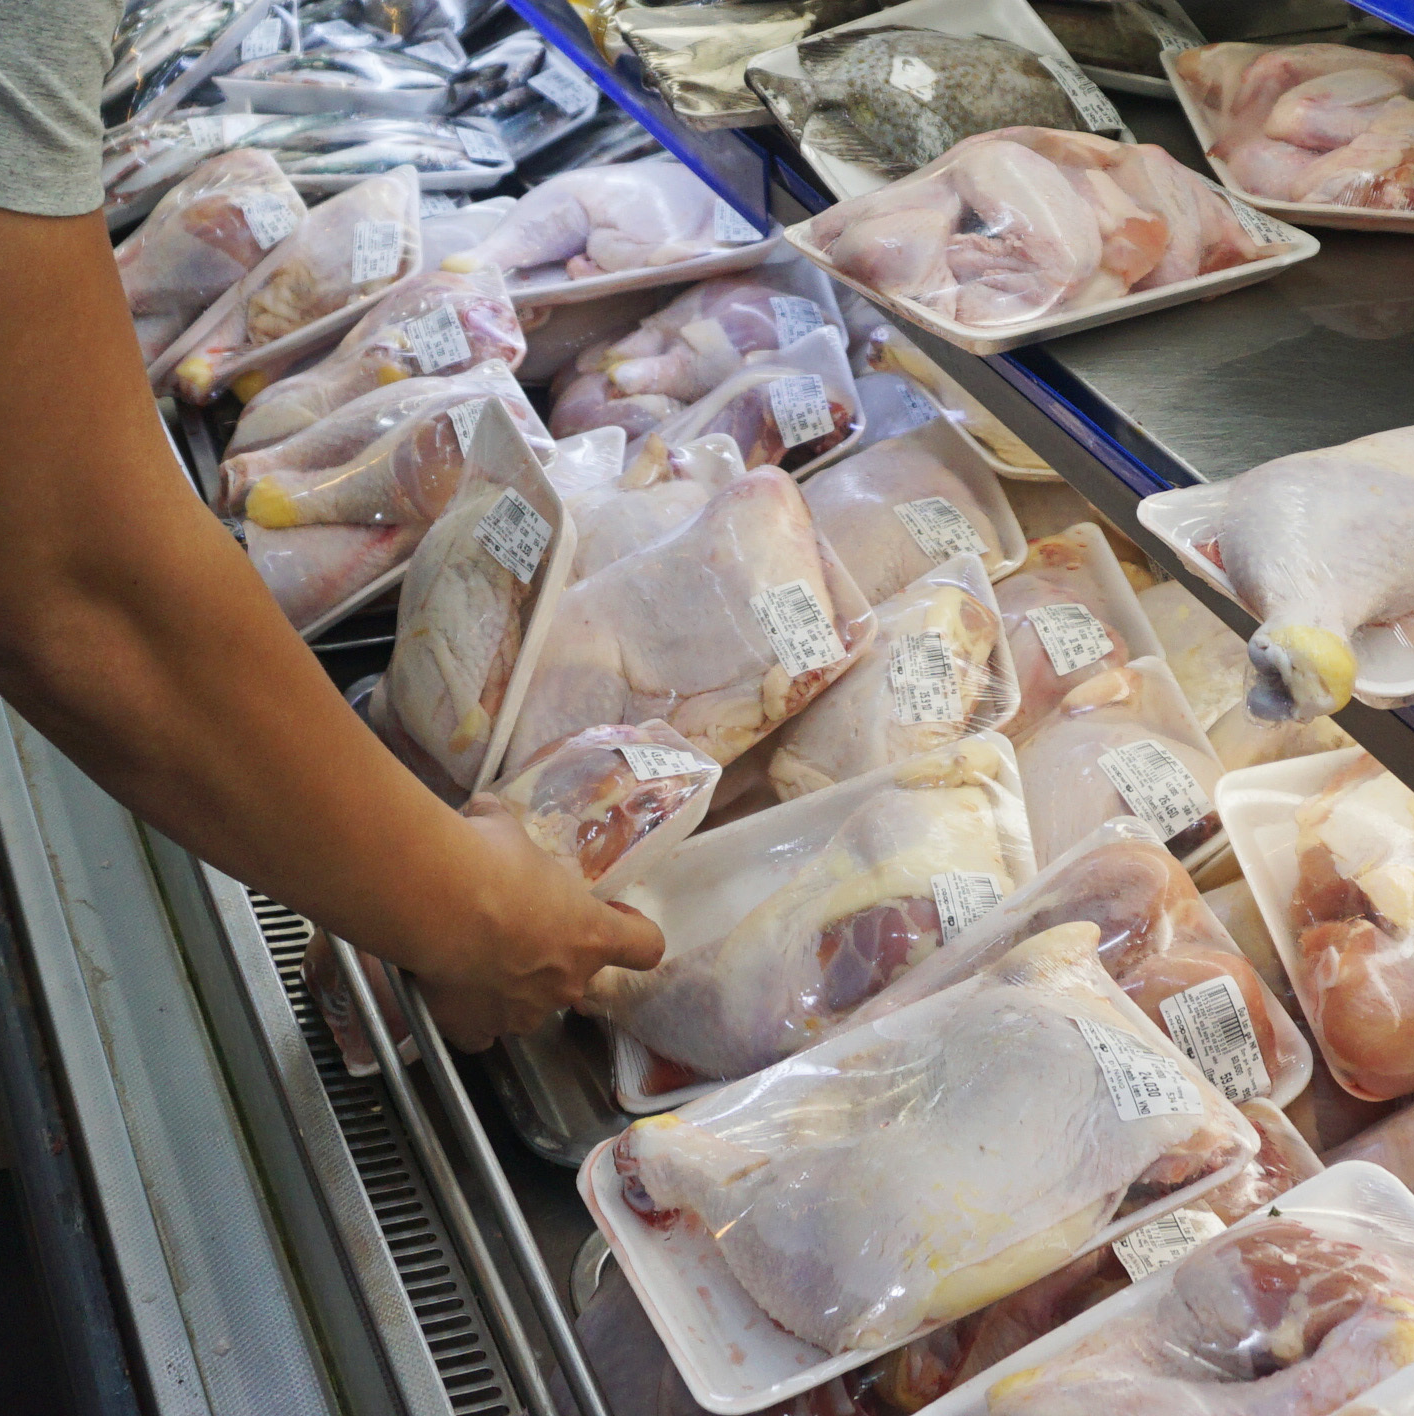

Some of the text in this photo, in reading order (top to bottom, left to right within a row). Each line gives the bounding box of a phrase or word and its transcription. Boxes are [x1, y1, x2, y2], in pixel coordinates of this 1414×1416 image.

[1155, 794, 1181, 819] 26.460
[1137, 1071, 1162, 1099] 24.030
[1217, 1071, 1239, 1100] 59.400
